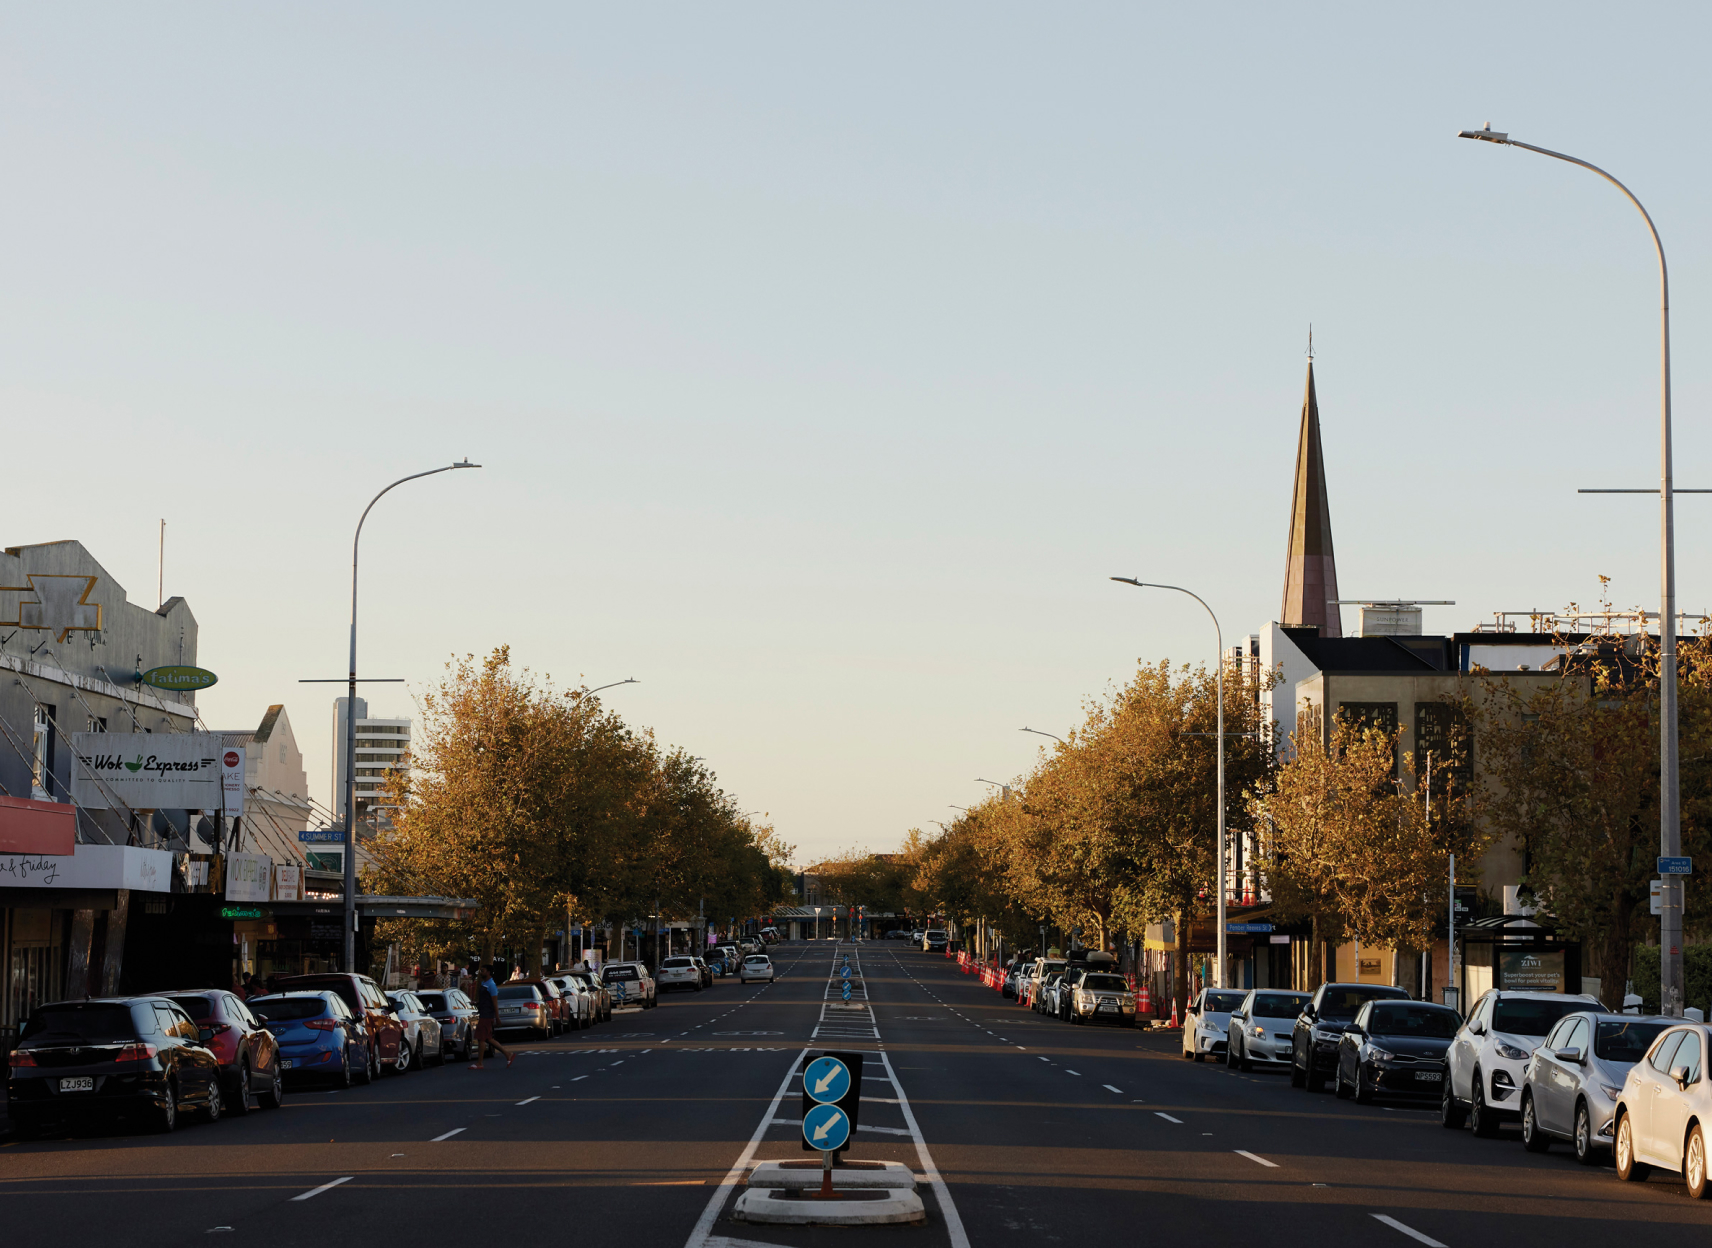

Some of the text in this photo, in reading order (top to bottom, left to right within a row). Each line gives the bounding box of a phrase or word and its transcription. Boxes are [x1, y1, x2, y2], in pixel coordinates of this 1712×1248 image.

[150, 669, 210, 684] fatima's
[94, 755, 199, 777] Wok Express
[305, 832, 343, 841] SUMMER ST
[8, 858, 17, 877] &
[19, 855, 60, 884] friday
[1415, 1072, 1442, 1082] NPS593
[60, 1079, 93, 1090] LZJ936
